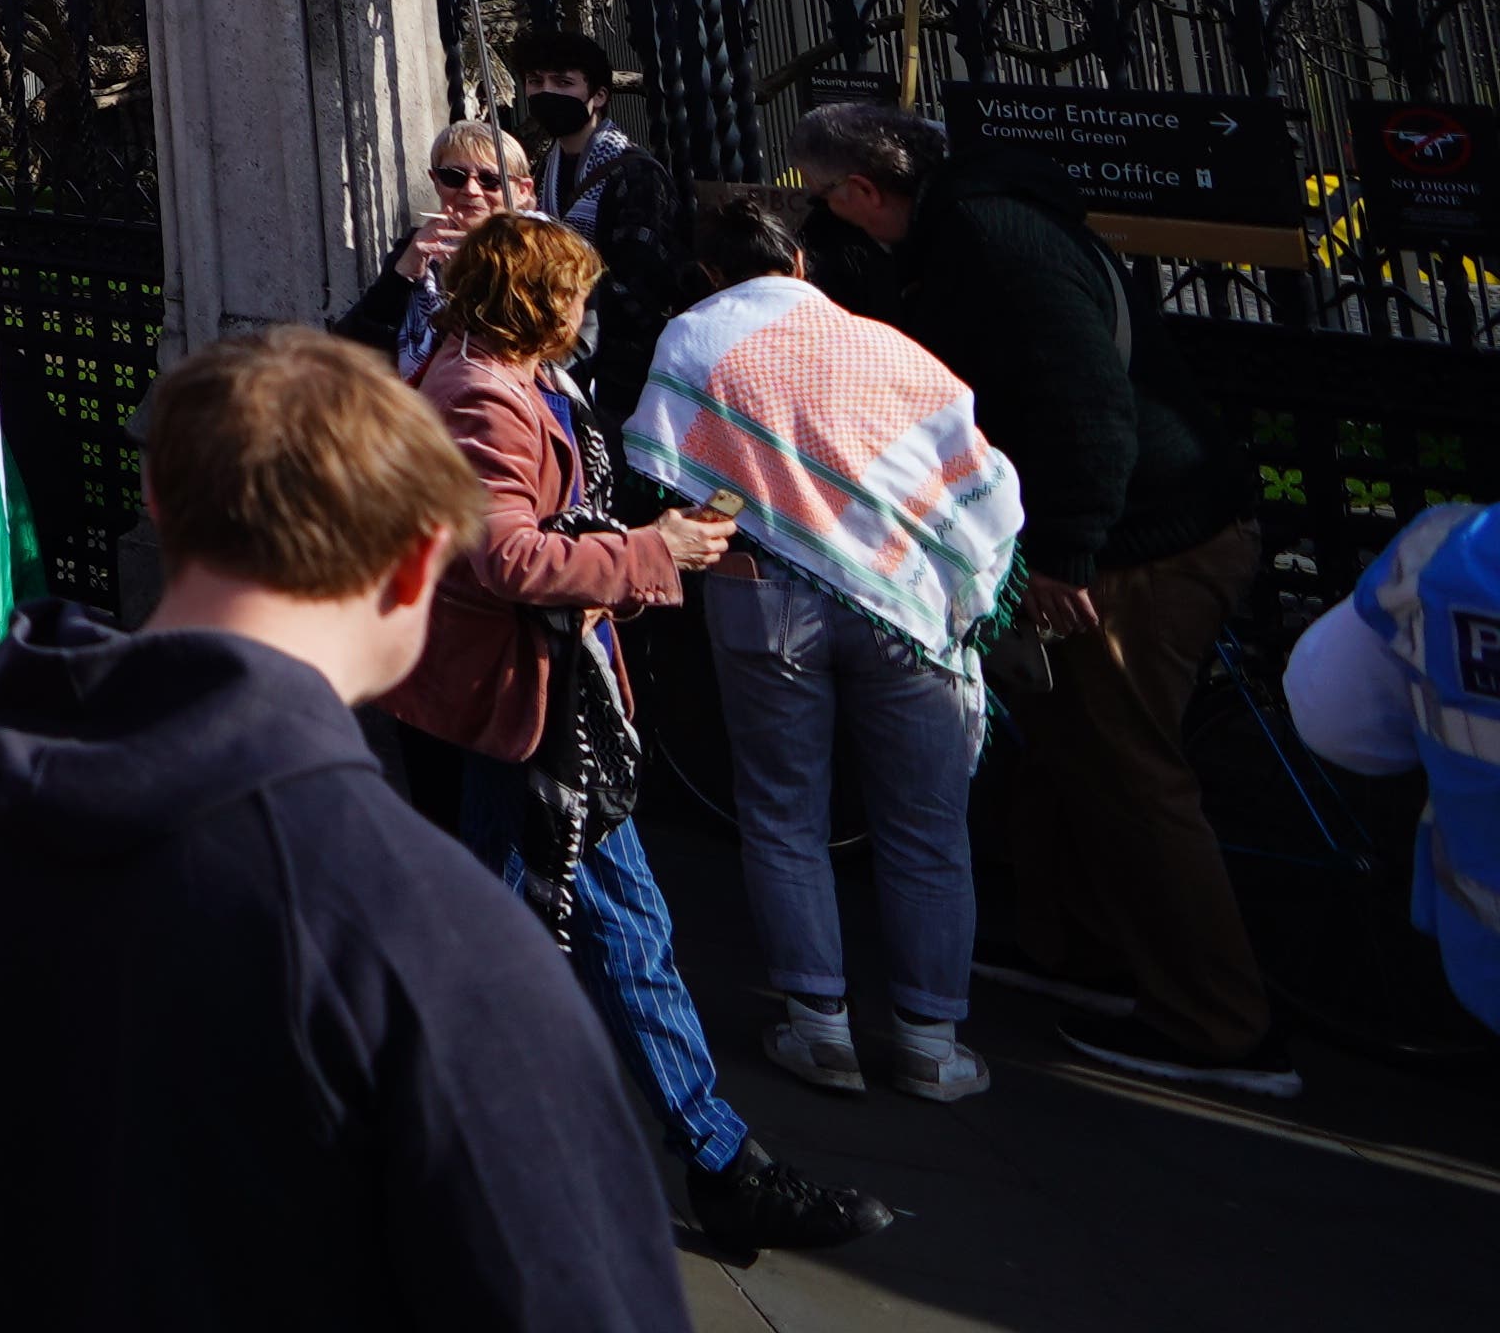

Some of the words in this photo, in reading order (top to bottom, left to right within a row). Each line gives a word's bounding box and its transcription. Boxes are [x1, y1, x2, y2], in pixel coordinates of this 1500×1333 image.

[977, 98, 1057, 122] Visitor
[1064, 104, 1181, 130] Entrance
[981, 122, 1066, 143] Cromwell
[1070, 128, 1129, 148] Green
[1100, 162, 1182, 187] Office
[1413, 192, 1461, 206] ZONE
[1467, 619, 1500, 661] P
